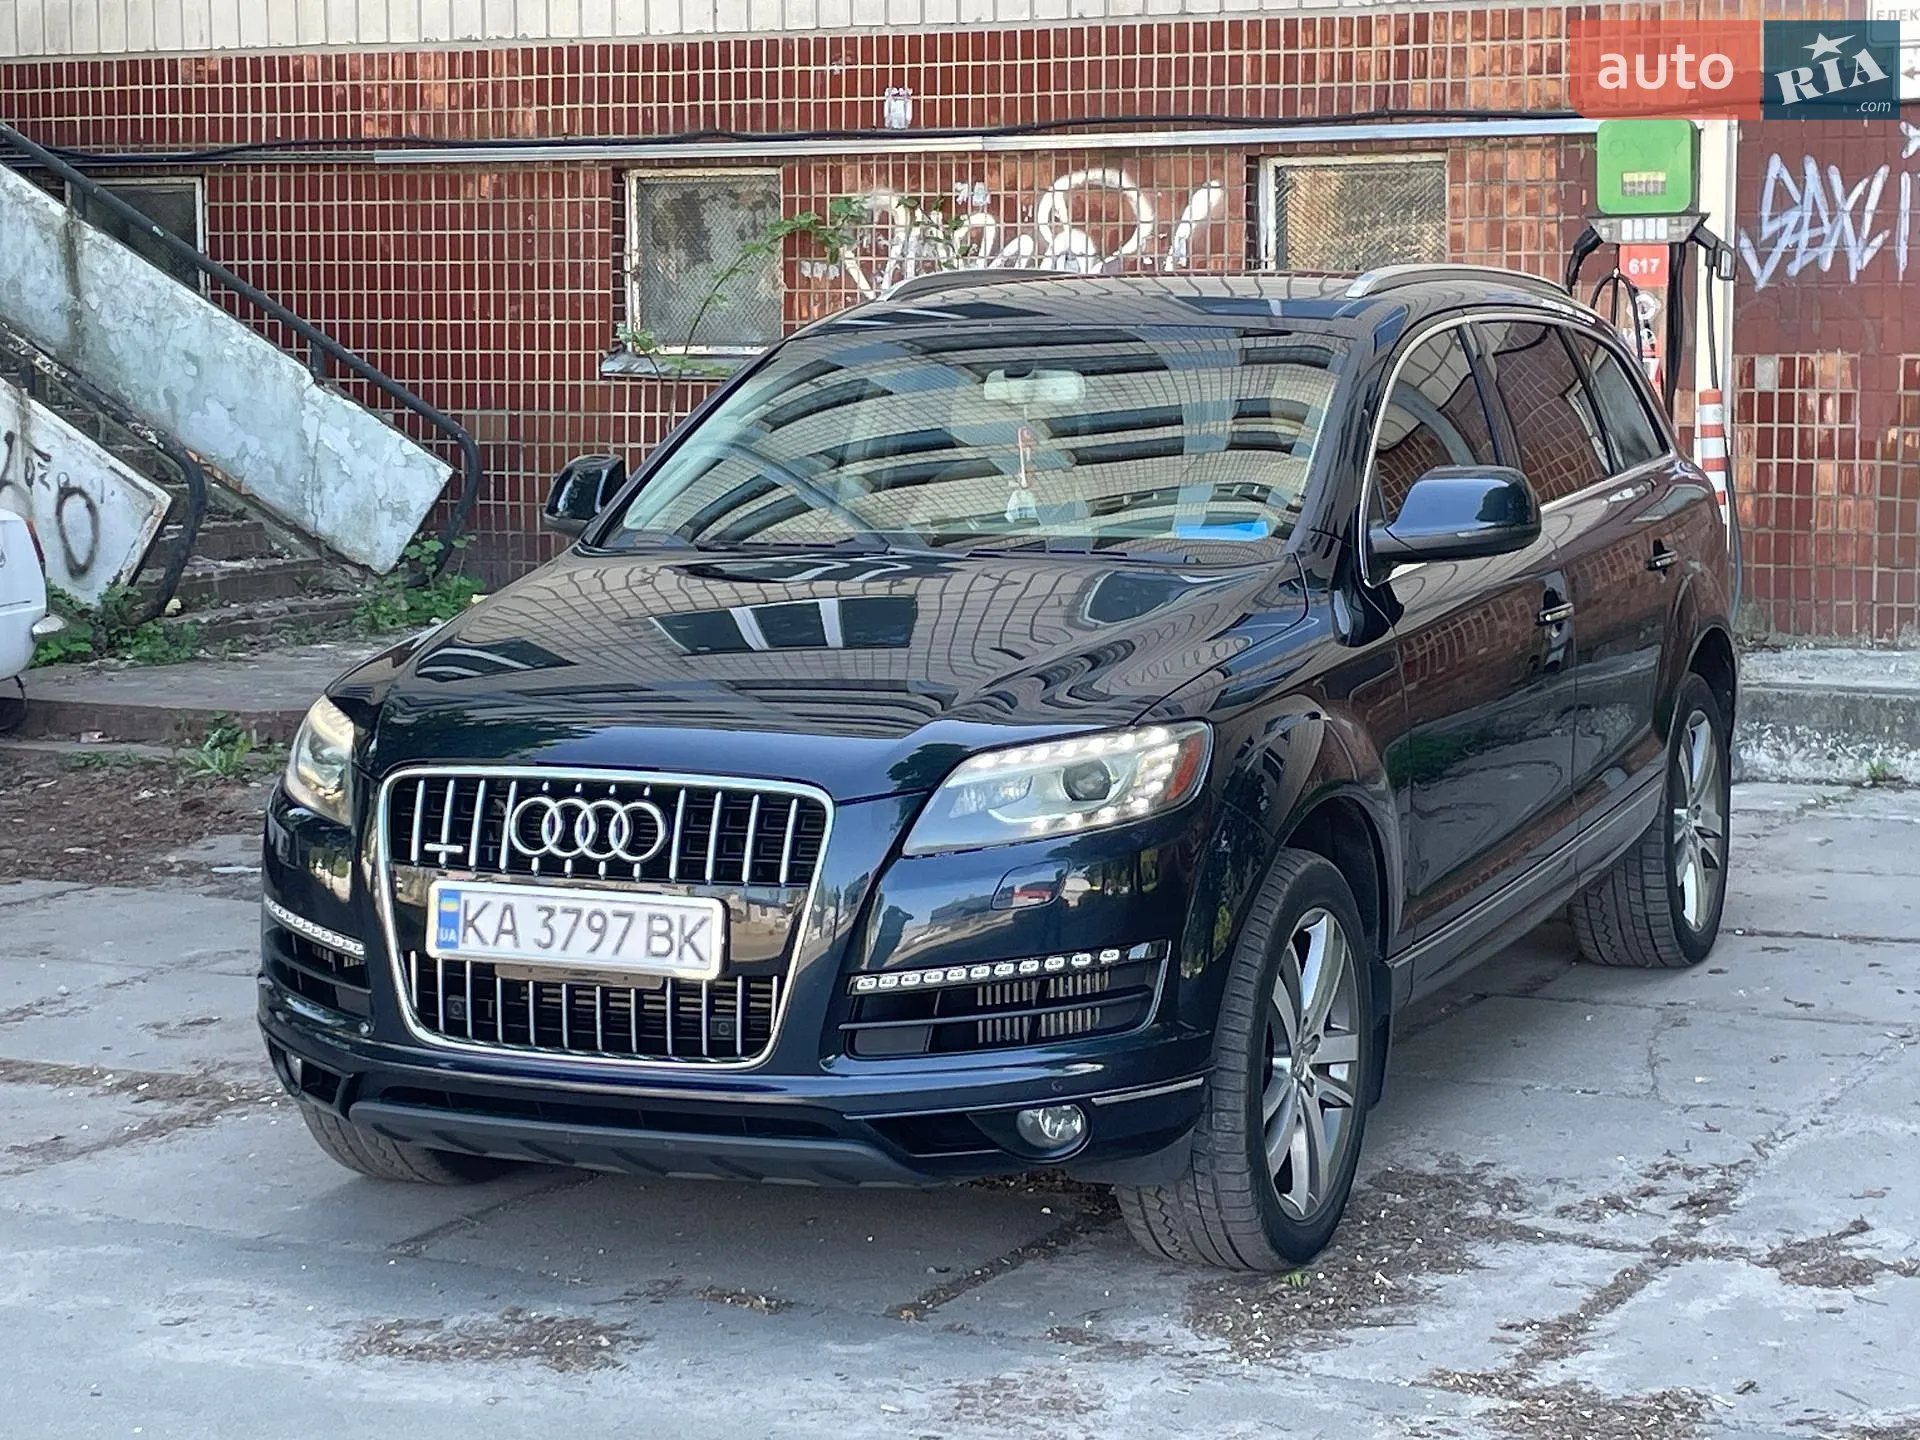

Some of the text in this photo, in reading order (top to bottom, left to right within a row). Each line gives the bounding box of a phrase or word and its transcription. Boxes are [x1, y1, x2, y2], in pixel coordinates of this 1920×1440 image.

[1629, 258, 1660, 275] 617
[440, 899, 709, 964] UA KA 3797 BK
